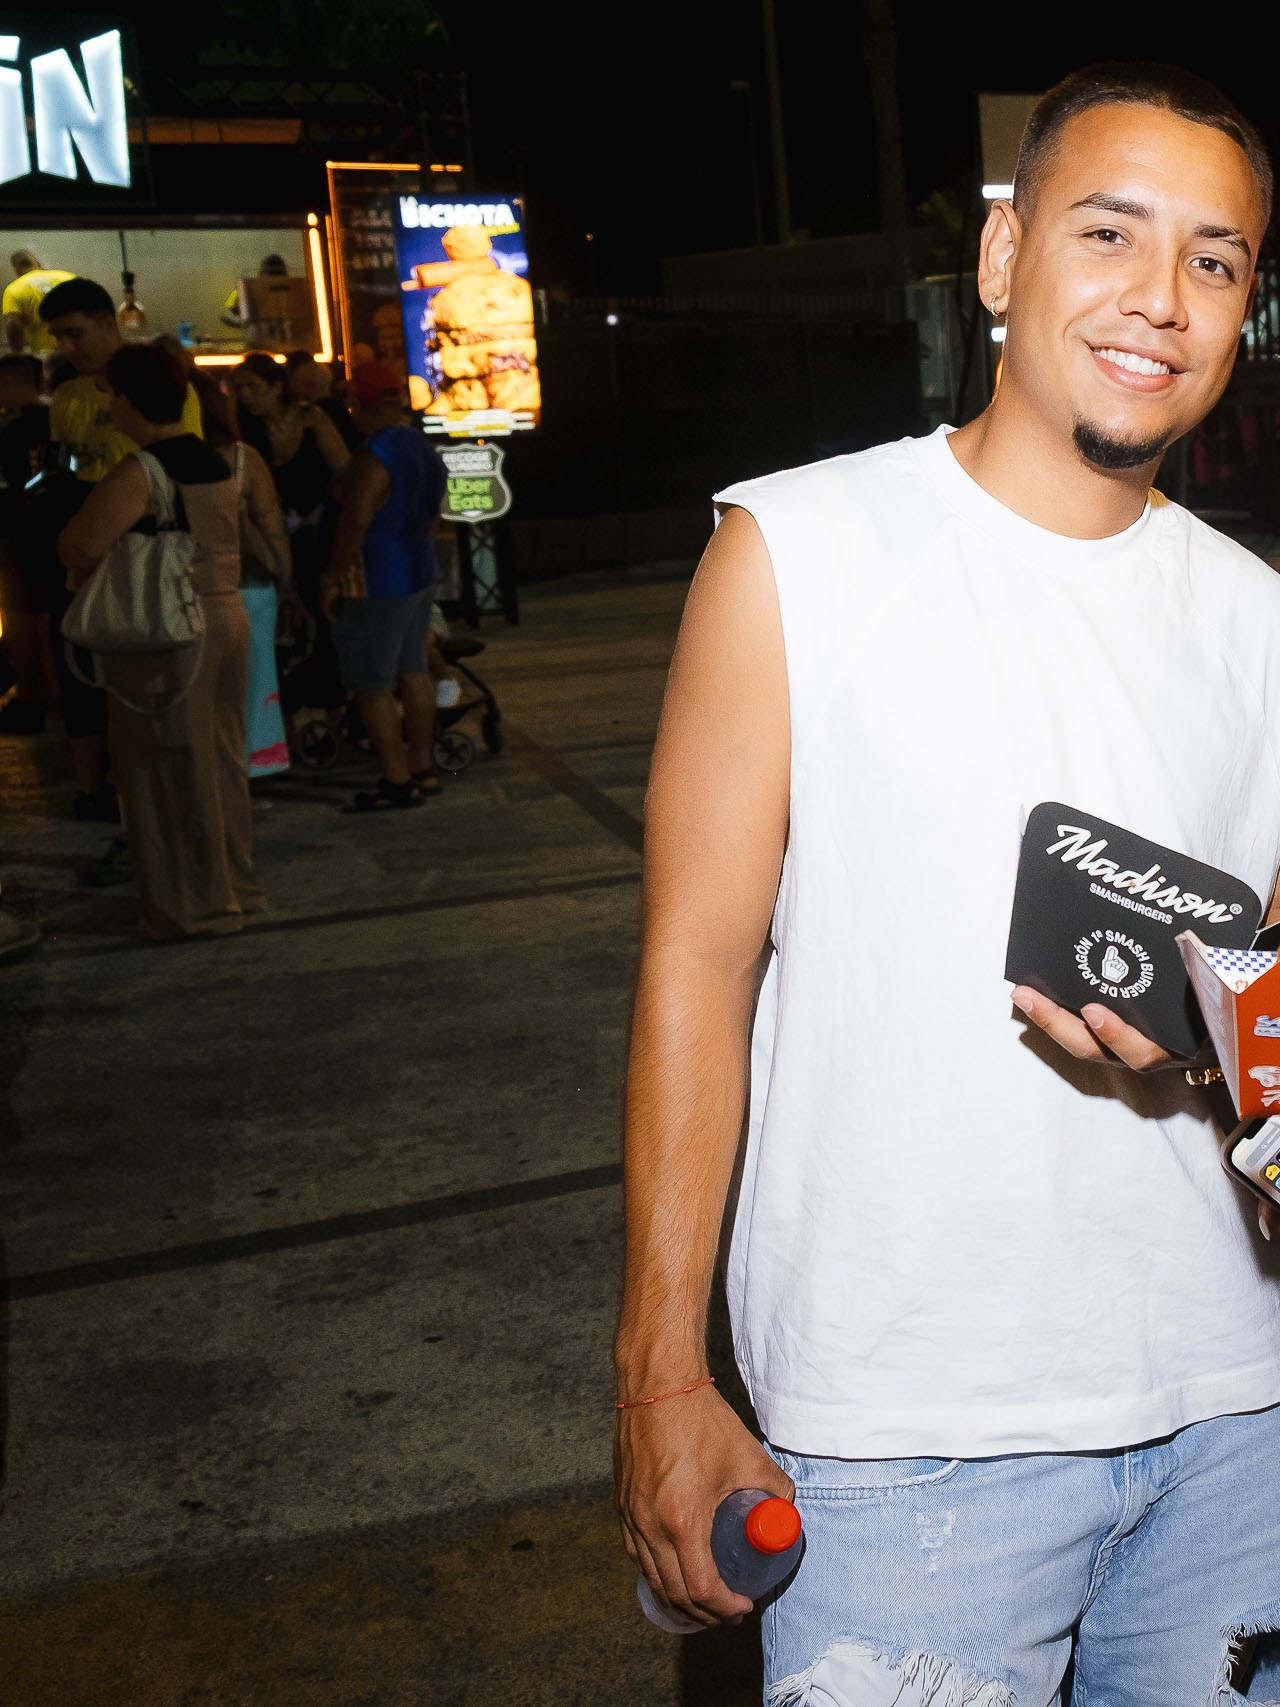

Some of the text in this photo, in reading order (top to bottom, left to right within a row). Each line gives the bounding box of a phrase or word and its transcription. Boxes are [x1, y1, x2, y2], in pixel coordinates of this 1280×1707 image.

[446, 478, 491, 494] Uber
[448, 494, 494, 511] Eats
[1089, 882, 1174, 925] SMASHBURGERS
[1073, 936, 1101, 986] ARAGÓN
[1105, 929, 1151, 962] SMASH
[1098, 982, 1118, 998] DE
[1119, 962, 1155, 999] BURGER
